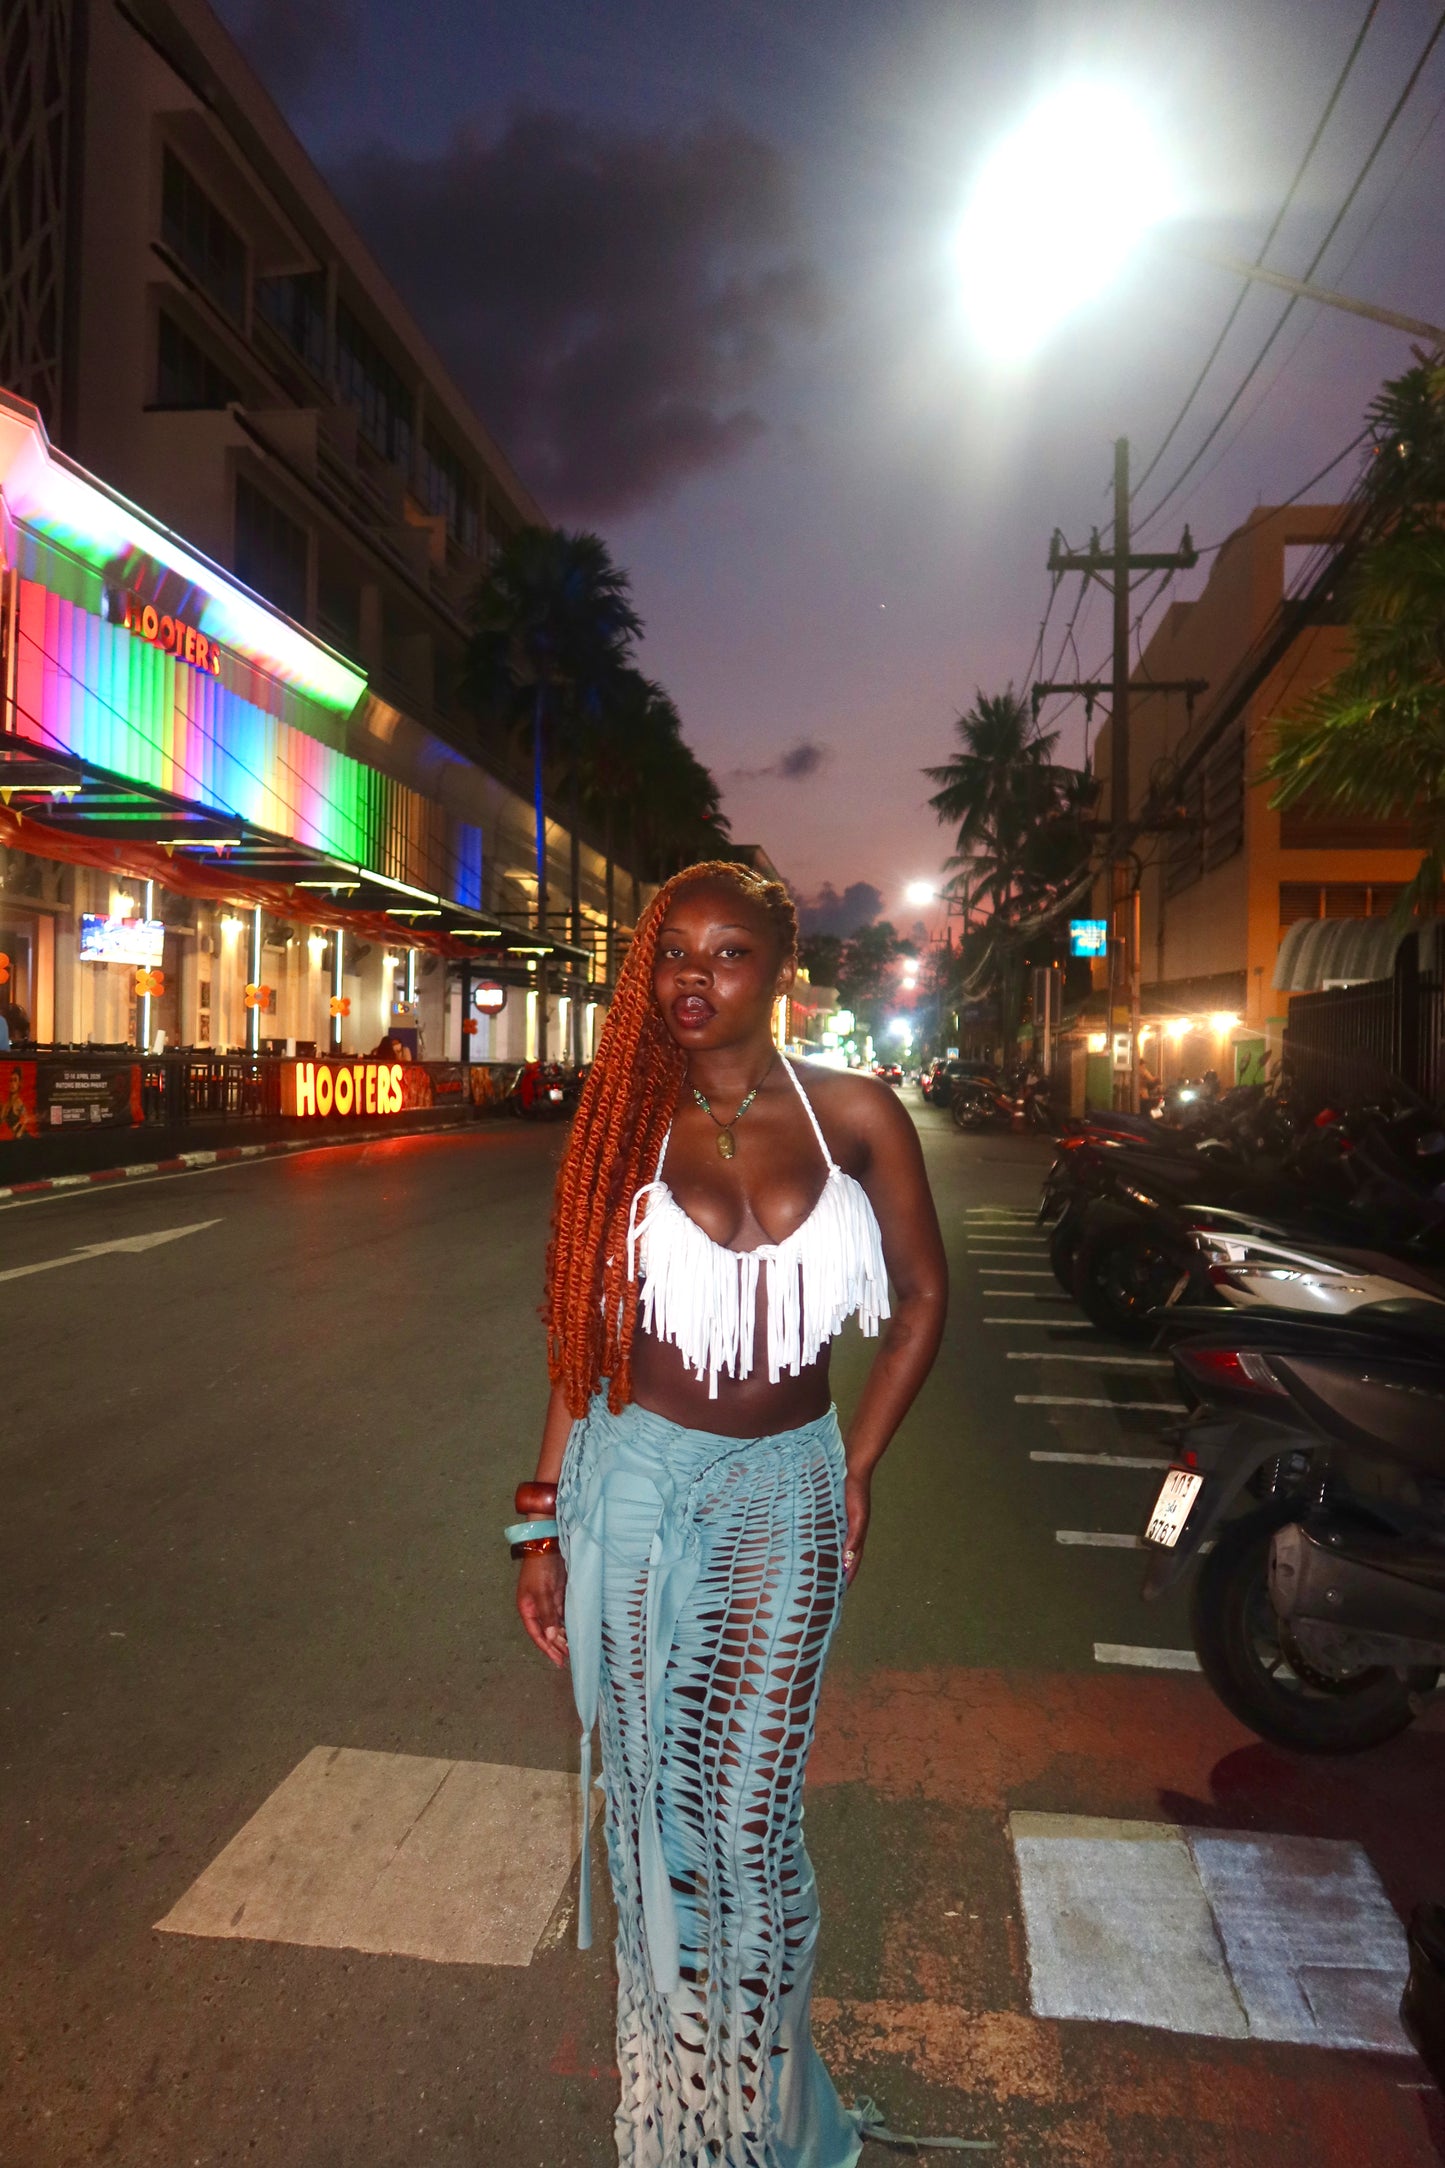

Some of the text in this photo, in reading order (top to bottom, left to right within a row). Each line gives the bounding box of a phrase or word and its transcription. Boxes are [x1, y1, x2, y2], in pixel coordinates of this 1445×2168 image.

[124, 592, 220, 677] HOOTERS
[296, 1062, 403, 1117] HOOTERS
[1148, 1518, 1177, 1546] 3767
